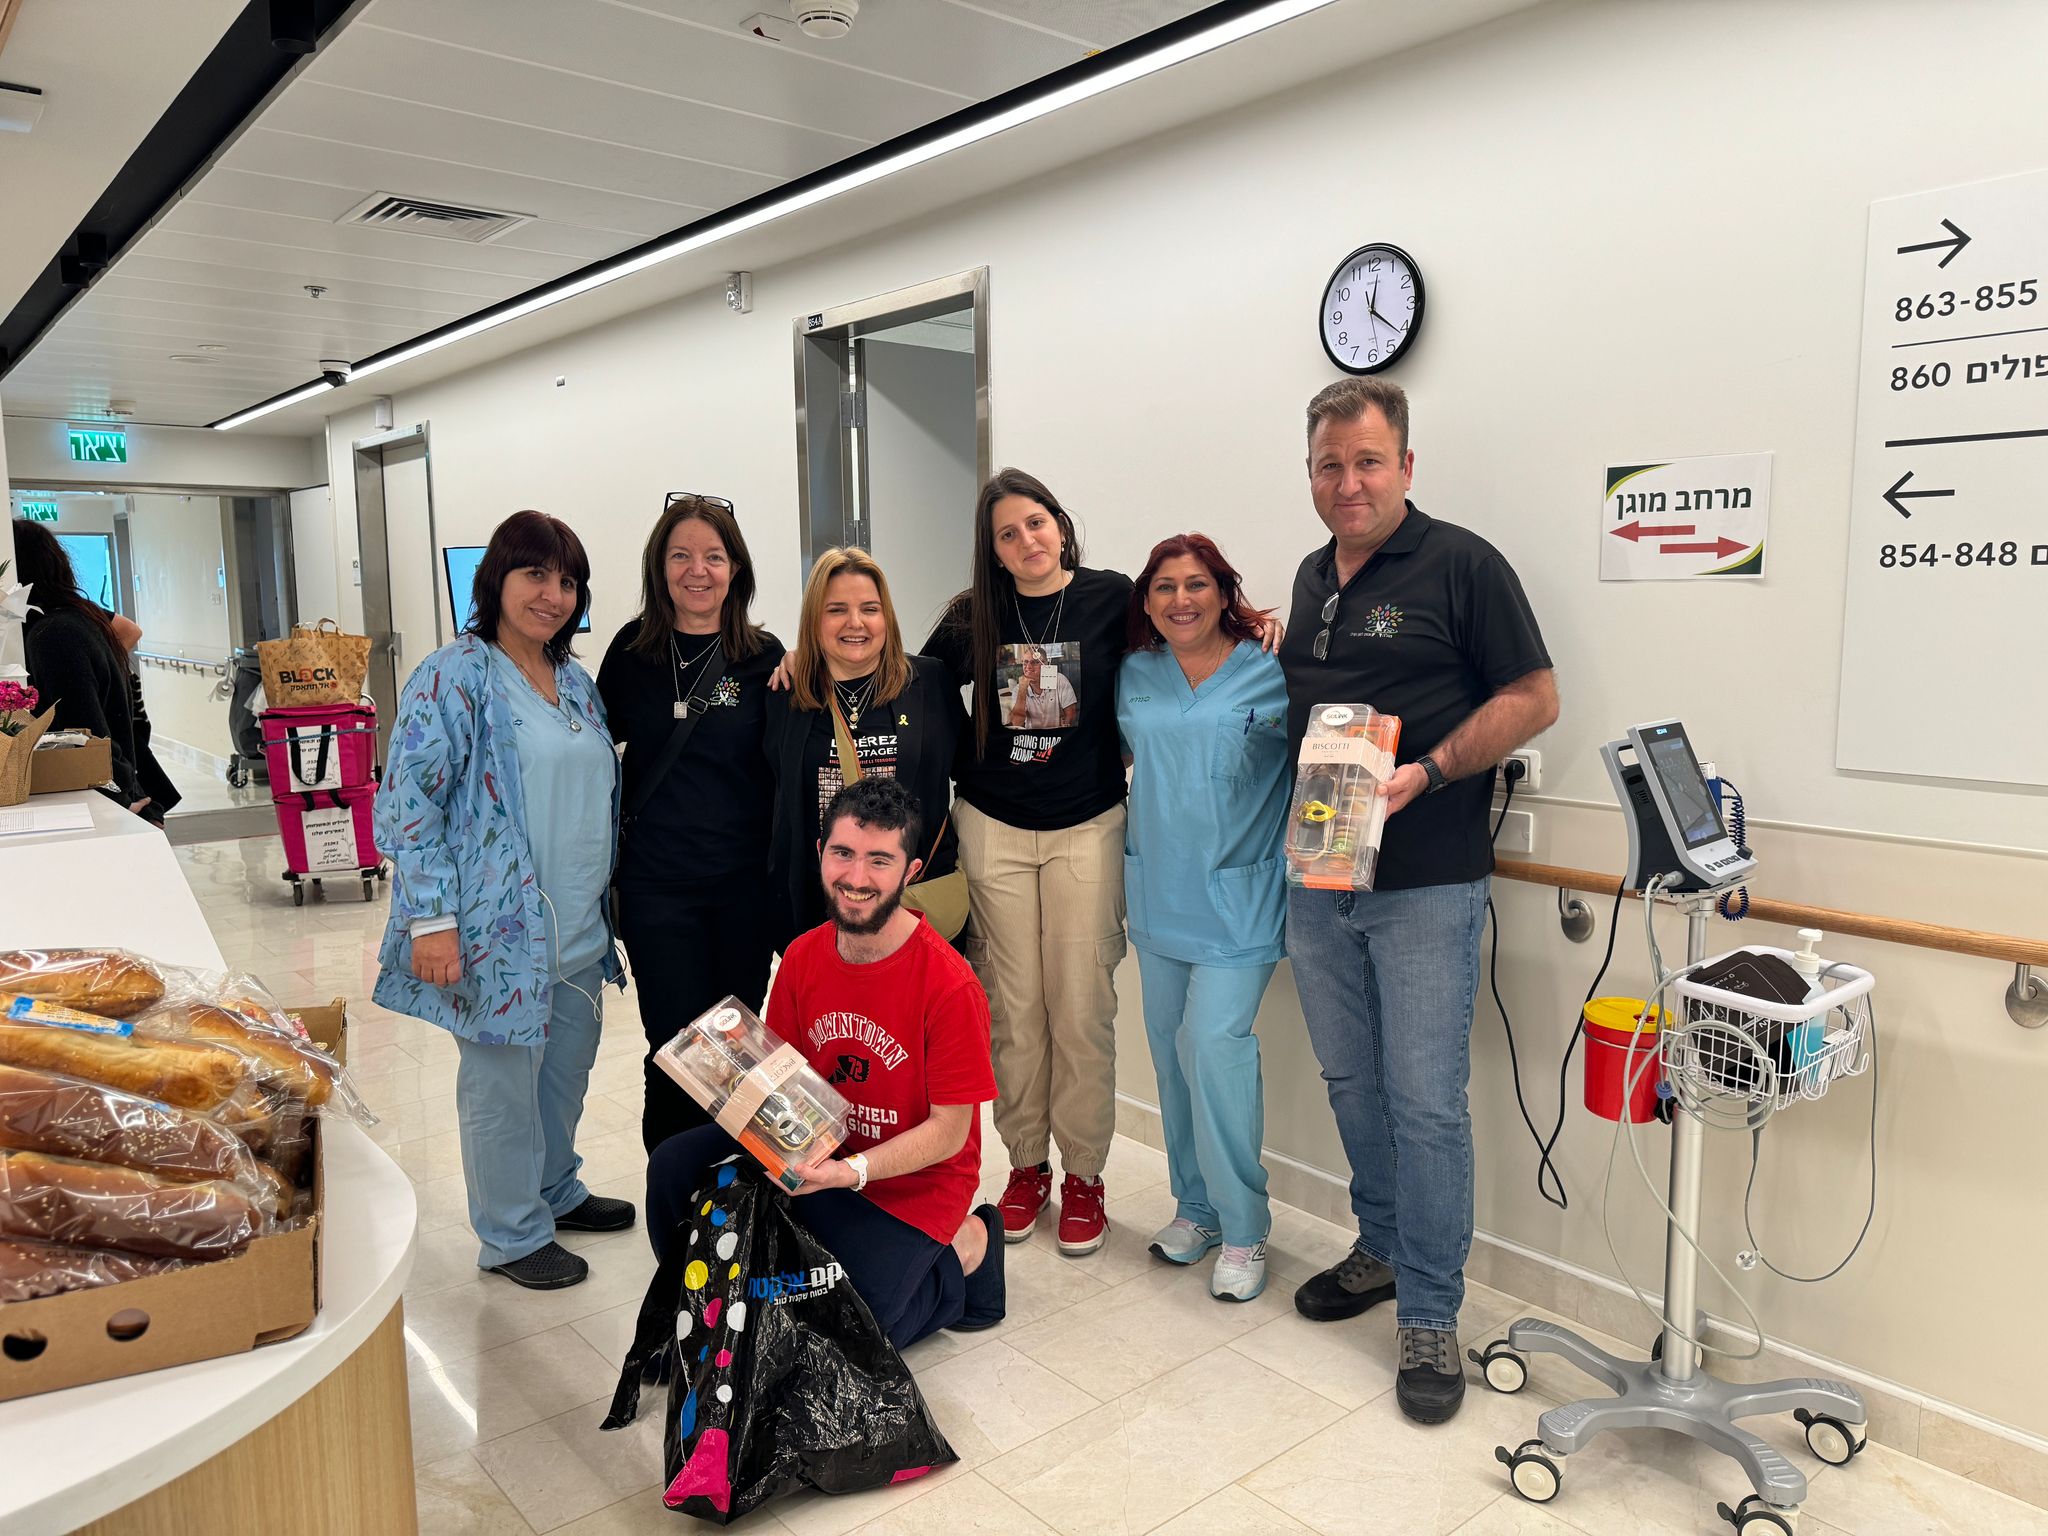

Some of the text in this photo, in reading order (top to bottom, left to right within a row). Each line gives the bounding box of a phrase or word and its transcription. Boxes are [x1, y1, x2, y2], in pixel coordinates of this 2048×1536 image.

[1368, 257, 1381, 272] 12
[1390, 259, 1395, 273] 1
[1352, 266, 1361, 282] 11
[1401, 274, 1411, 289] 2
[1336, 287, 1350, 302] 10
[1895, 278, 2038, 322] 863-855
[1406, 295, 1416, 311] 3
[1333, 310, 1342, 325] 9
[1400, 319, 1409, 333] 4
[1338, 331, 1348, 346] 8
[1386, 338, 1396, 354] 5
[1350, 345, 1360, 361] 7
[1368, 348, 1378, 363] 6
[1890, 353, 2048, 391] פולים 860
[69, 433, 125, 462] יציאה
[22, 503, 58, 521] יציאה
[1616, 487, 1752, 521] מרחב מוגן
[1879, 541, 2018, 568] 854-848
[1013, 734, 1038, 750] BRING
[1312, 742, 1350, 751] BISCOTTI
[1010, 746, 1035, 763] HOME
[858, 1104, 898, 1125] FIELD
[848, 1118, 881, 1140] SION
